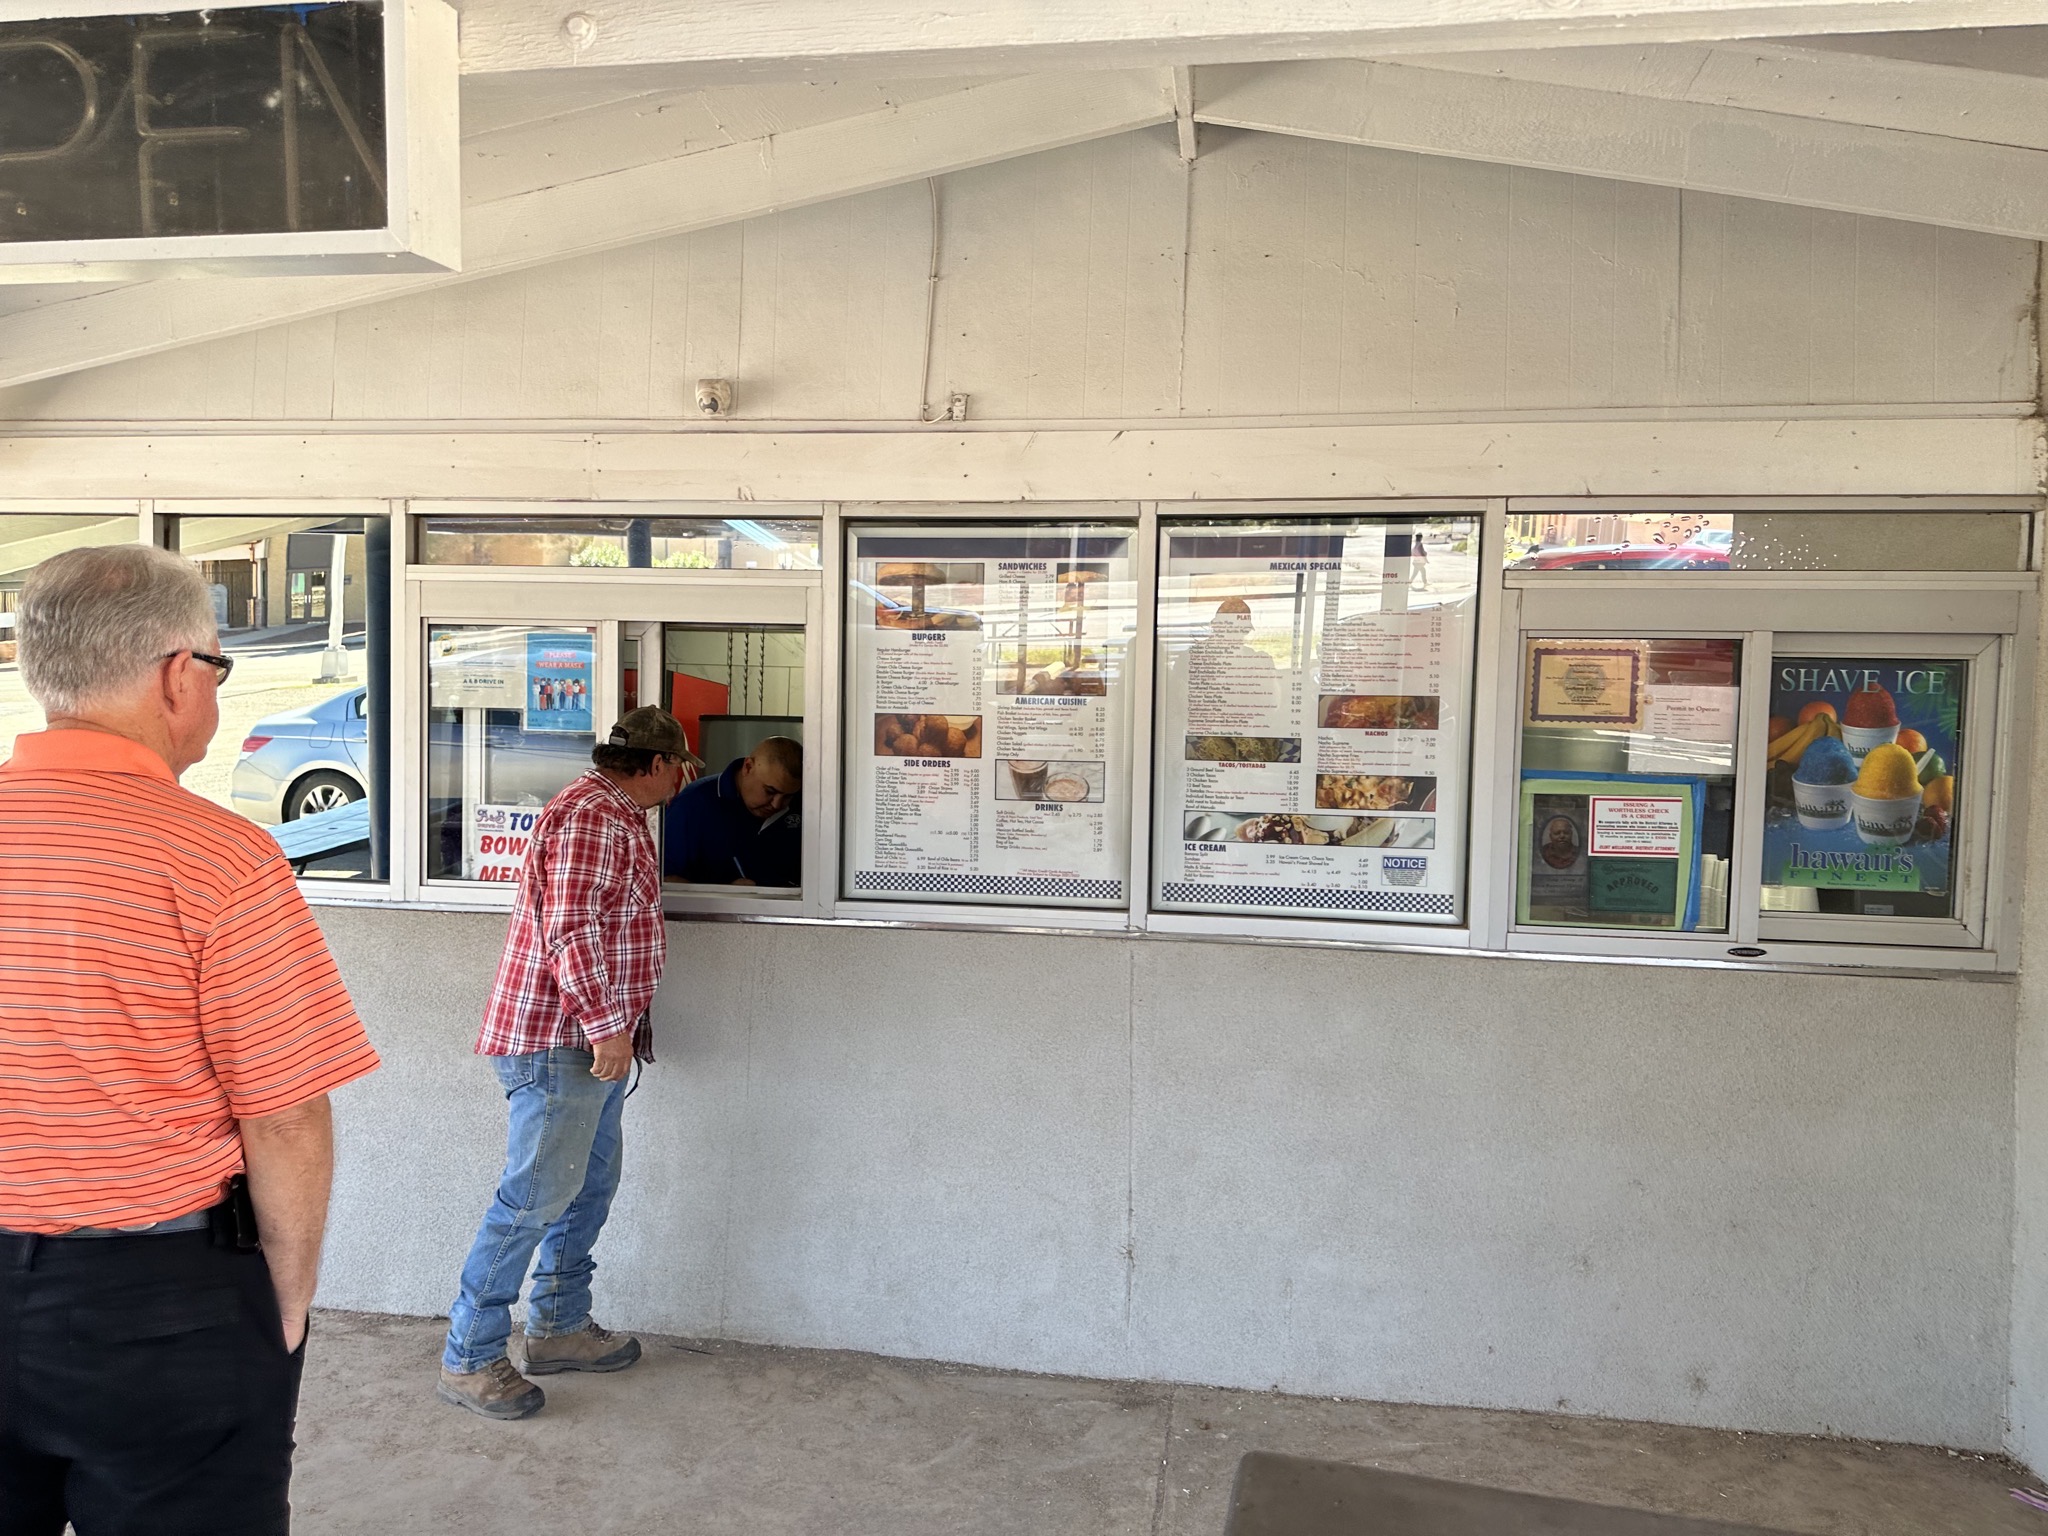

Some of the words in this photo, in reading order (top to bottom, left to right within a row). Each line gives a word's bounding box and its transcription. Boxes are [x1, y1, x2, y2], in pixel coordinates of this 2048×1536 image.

[998, 562, 1047, 570] SANDWICHES
[1270, 562, 1307, 570] MEXICAN
[1781, 668, 1880, 693] SHAVE
[1895, 670, 1946, 695] ICE
[1015, 697, 1055, 706] AMERICAN
[1058, 698, 1087, 706] CUISINE
[510, 813, 540, 831] TO
[480, 835, 528, 856] BOW
[1185, 843, 1196, 851] ICE
[1199, 844, 1226, 852] CREAM
[1384, 858, 1426, 868] NOTICE
[480, 866, 522, 881] MEN
[1789, 870, 1912, 883] FINEST
[1606, 876, 1659, 894] APPROVED
